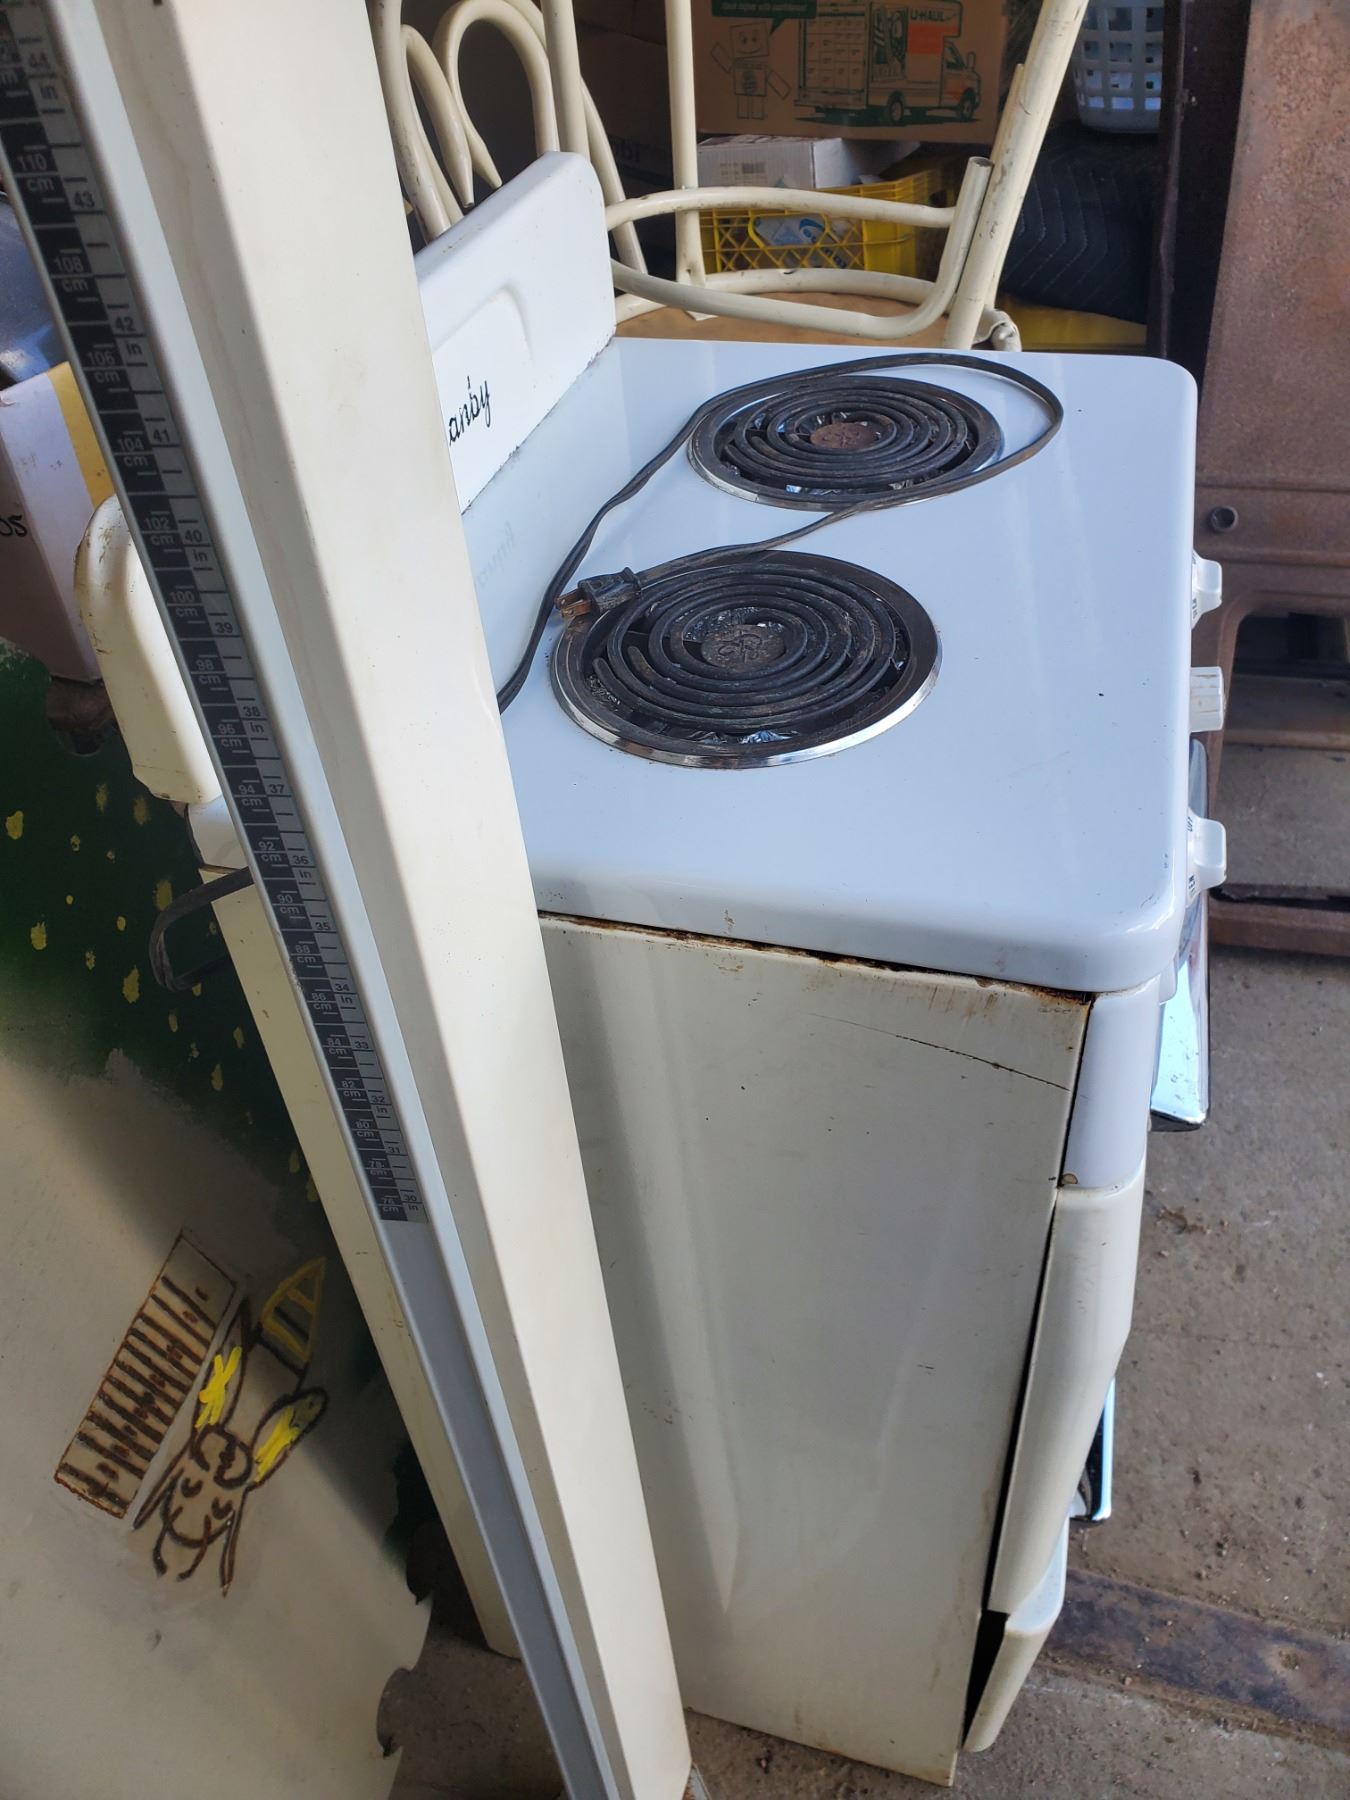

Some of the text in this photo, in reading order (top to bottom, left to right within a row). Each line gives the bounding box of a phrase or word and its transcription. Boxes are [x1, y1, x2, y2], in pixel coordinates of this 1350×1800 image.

[17, 152, 48, 172] 110
[26, 178, 55, 192] cm
[73, 191, 96, 208] 43
[54, 256, 84, 272] 108
[61, 279, 88, 292] cm
[115, 317, 137, 332] 42
[125, 341, 143, 355] in
[86, 351, 116, 366] 106
[93, 370, 120, 383] cm
[152, 429, 171, 442] 41
[118, 437, 145, 451] 104
[123, 456, 149, 467] cm
[145, 517, 172, 530] 102
[150, 535, 175, 546] cm
[184, 529, 203, 543] 40
[192, 549, 208, 562] in
[169, 591, 196, 603] 100
[175, 607, 199, 618] cm
[214, 622, 234, 634] 39
[196, 660, 215, 671] 98
[199, 674, 222, 685] cm
[242, 706, 261, 717] 38
[250, 721, 265, 733] in
[220, 738, 243, 748] cm
[238, 784, 256, 795] 94
[268, 783, 285, 794] 37
[241, 798, 263, 807] cm
[258, 841, 276, 851] 92
[261, 853, 282, 863] cm
[292, 855, 310, 865] 36
[298, 870, 313, 879] in
[276, 894, 293, 904] 90
[280, 906, 300, 915] cm
[315, 921, 330, 931] 35
[297, 956, 316, 964] cm
[335, 983, 351, 992] 34
[312, 992, 327, 1001] 86
[341, 995, 353, 1004] in
[313, 1002, 333, 1010] cm
[354, 1041, 369, 1050] 33
[341, 1080, 356, 1088] 82
[343, 1090, 361, 1098] cm
[371, 1095, 386, 1104] 32
[376, 1105, 388, 1113] in
[355, 1120, 370, 1129] 80
[388, 1146, 402, 1154] 31
[404, 1194, 418, 1202] 30
[383, 1206, 400, 1214] cm
